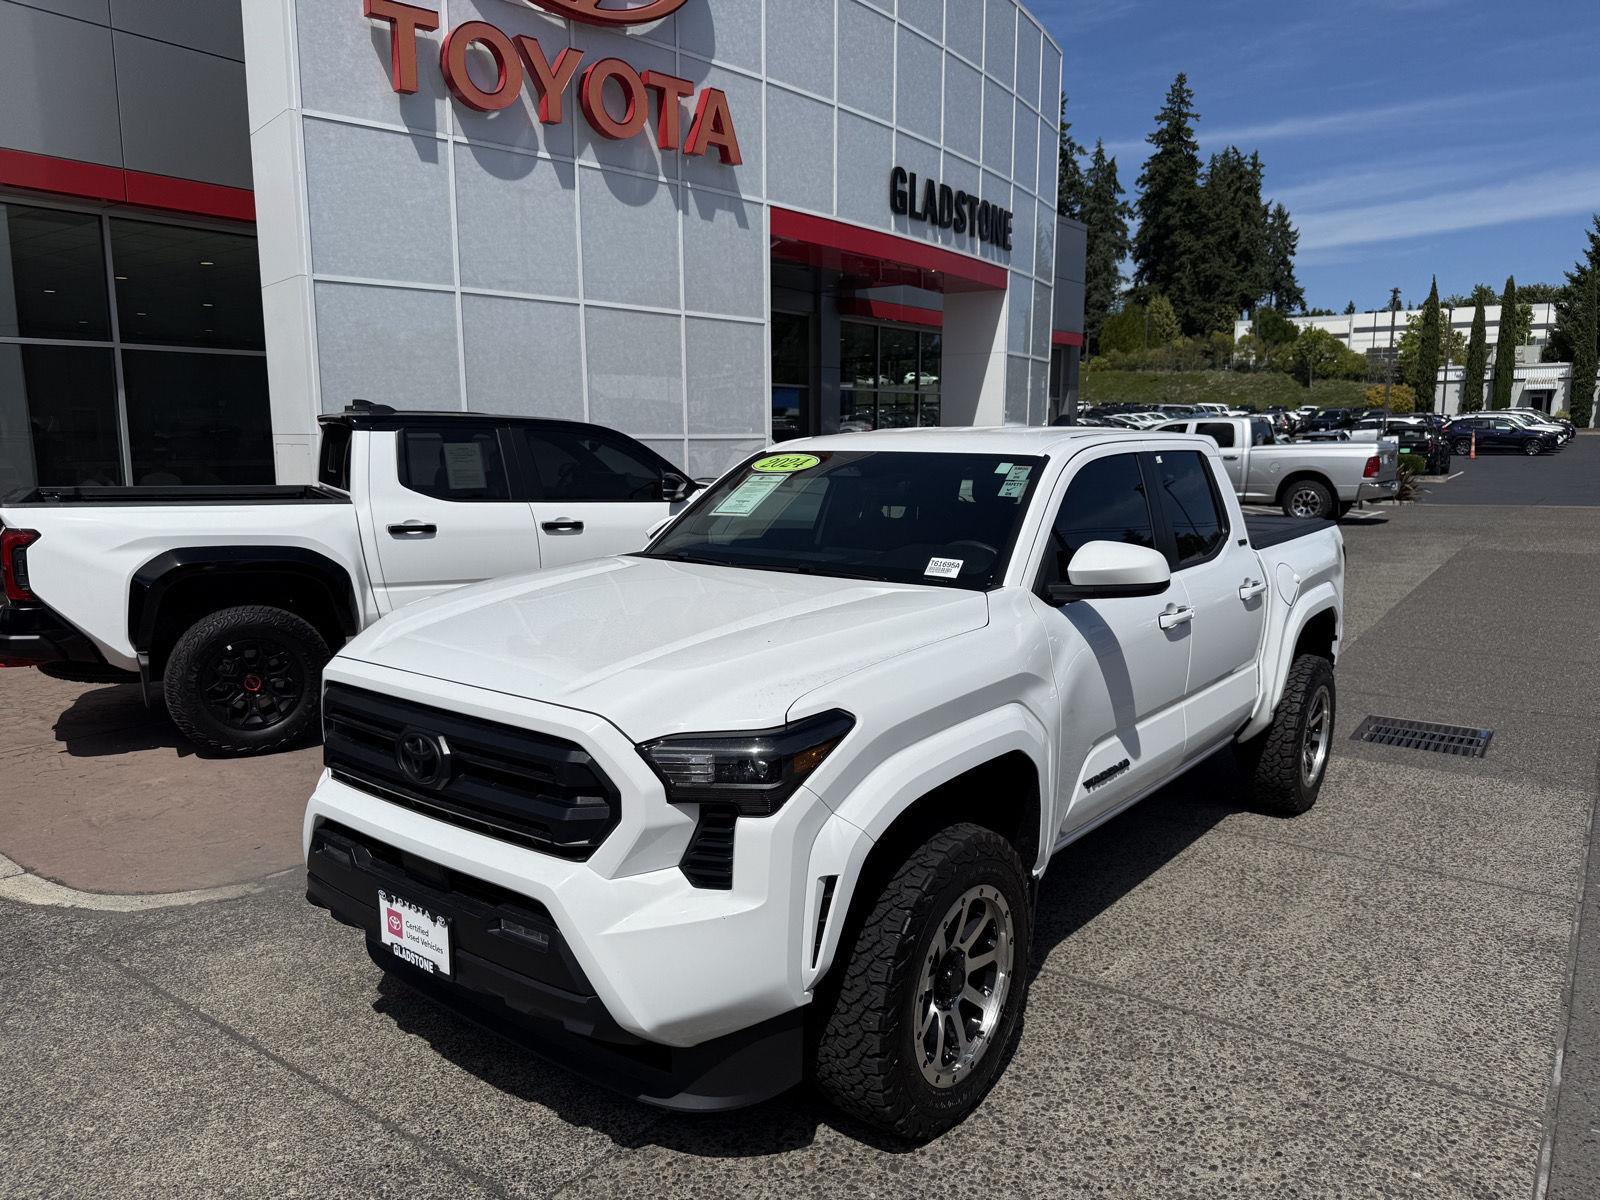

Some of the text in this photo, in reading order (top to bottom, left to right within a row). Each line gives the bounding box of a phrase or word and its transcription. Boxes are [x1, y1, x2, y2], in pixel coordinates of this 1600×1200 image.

[364, 0, 742, 166] TOYOTA
[890, 166, 1013, 251] GLADSTONE
[760, 457, 812, 468] 2024
[391, 894, 431, 919] TOYOTA
[405, 920, 429, 937] Certified
[406, 931, 444, 955] Used Vehicles
[393, 943, 434, 974] GLADSTONE
